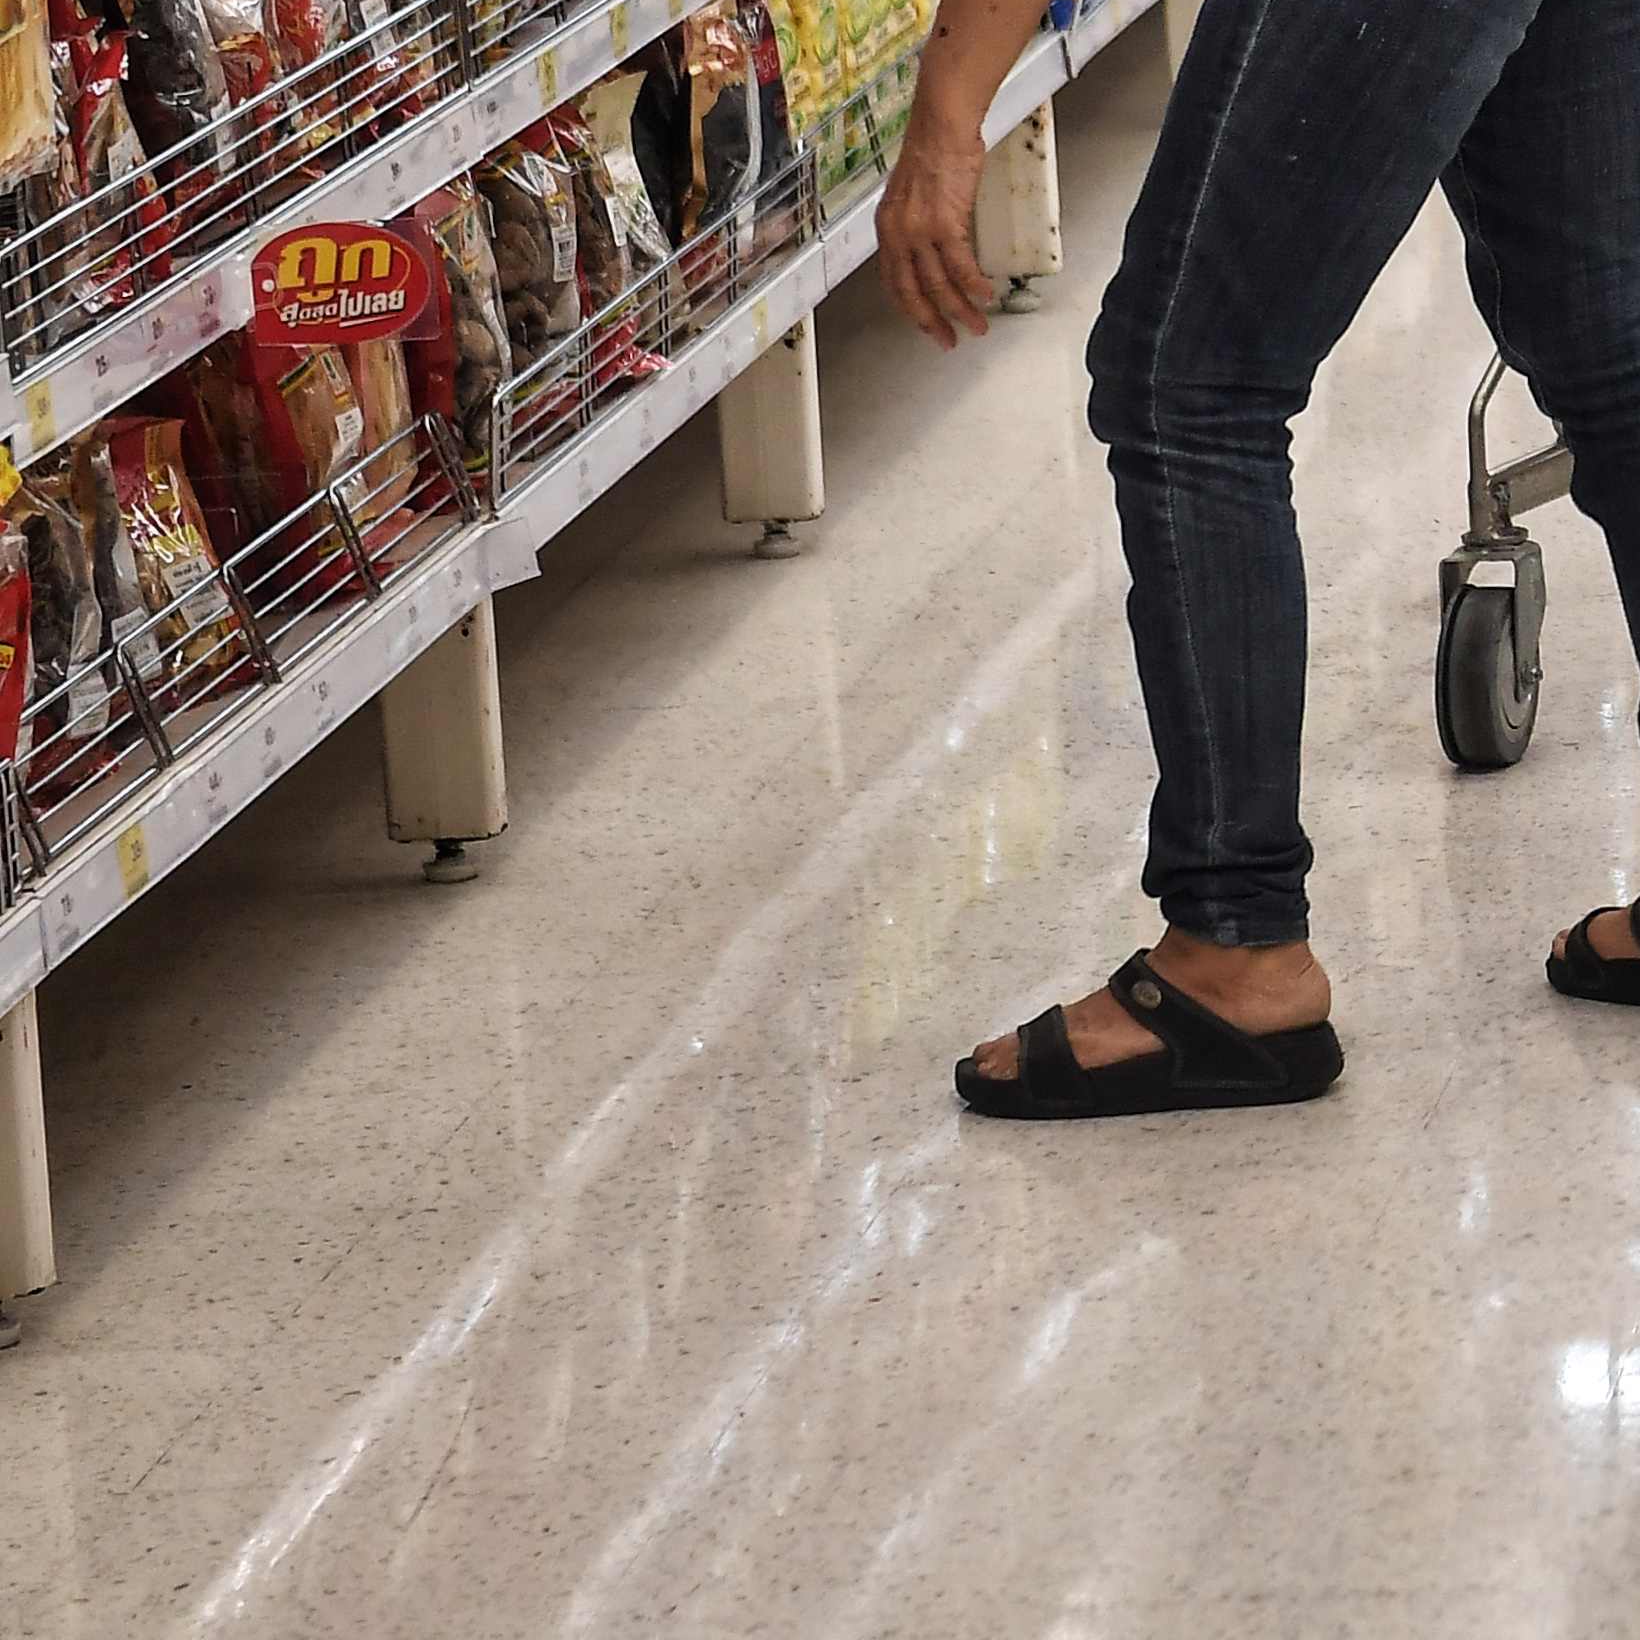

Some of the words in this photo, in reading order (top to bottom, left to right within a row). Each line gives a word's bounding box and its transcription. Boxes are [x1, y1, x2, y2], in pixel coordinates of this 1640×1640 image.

[276, 236, 391, 303] ถูก
[280, 287, 405, 328] สุดสุดไปเลย
